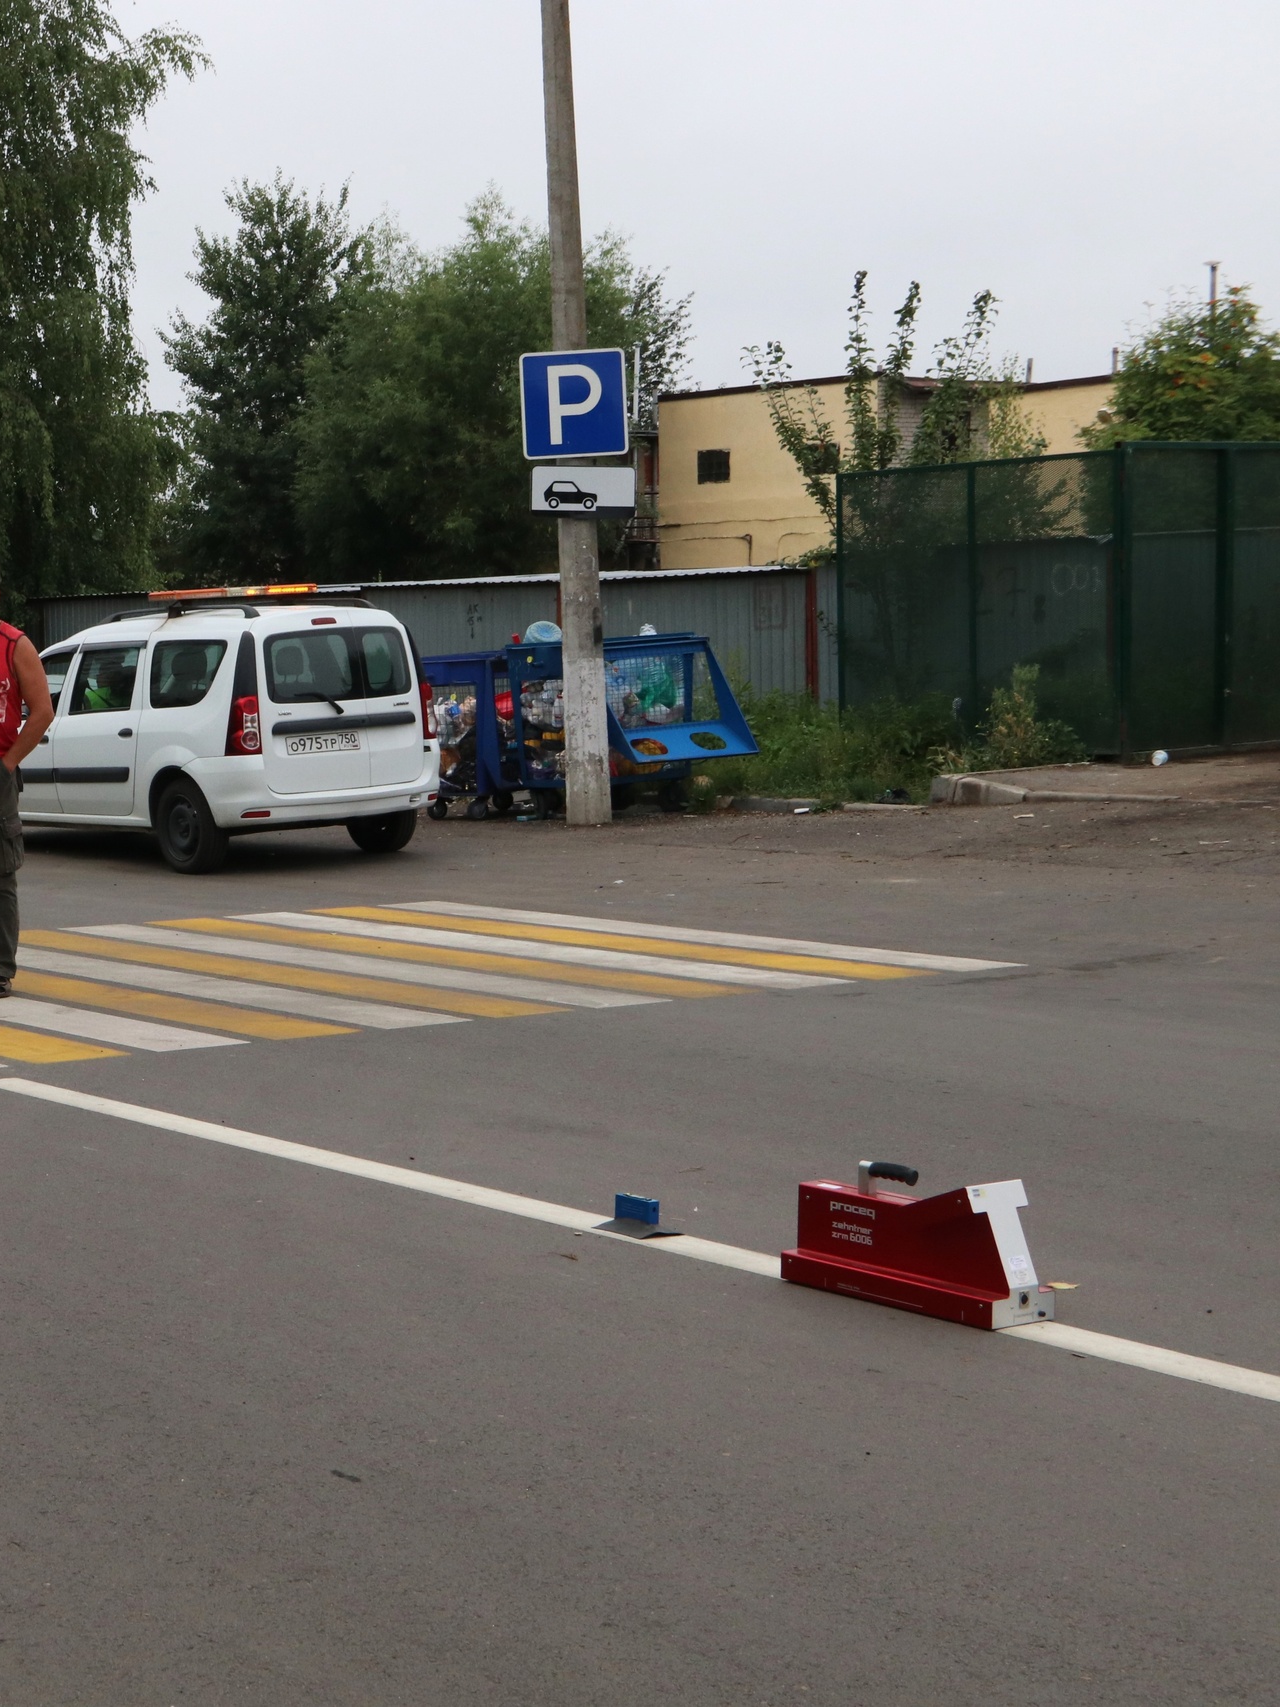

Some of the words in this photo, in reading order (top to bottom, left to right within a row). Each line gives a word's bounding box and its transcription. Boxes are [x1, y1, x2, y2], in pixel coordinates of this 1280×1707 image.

[547, 364, 602, 446] P
[830, 1201, 876, 1220] proceq
[831, 1231, 849, 1241] zrm
